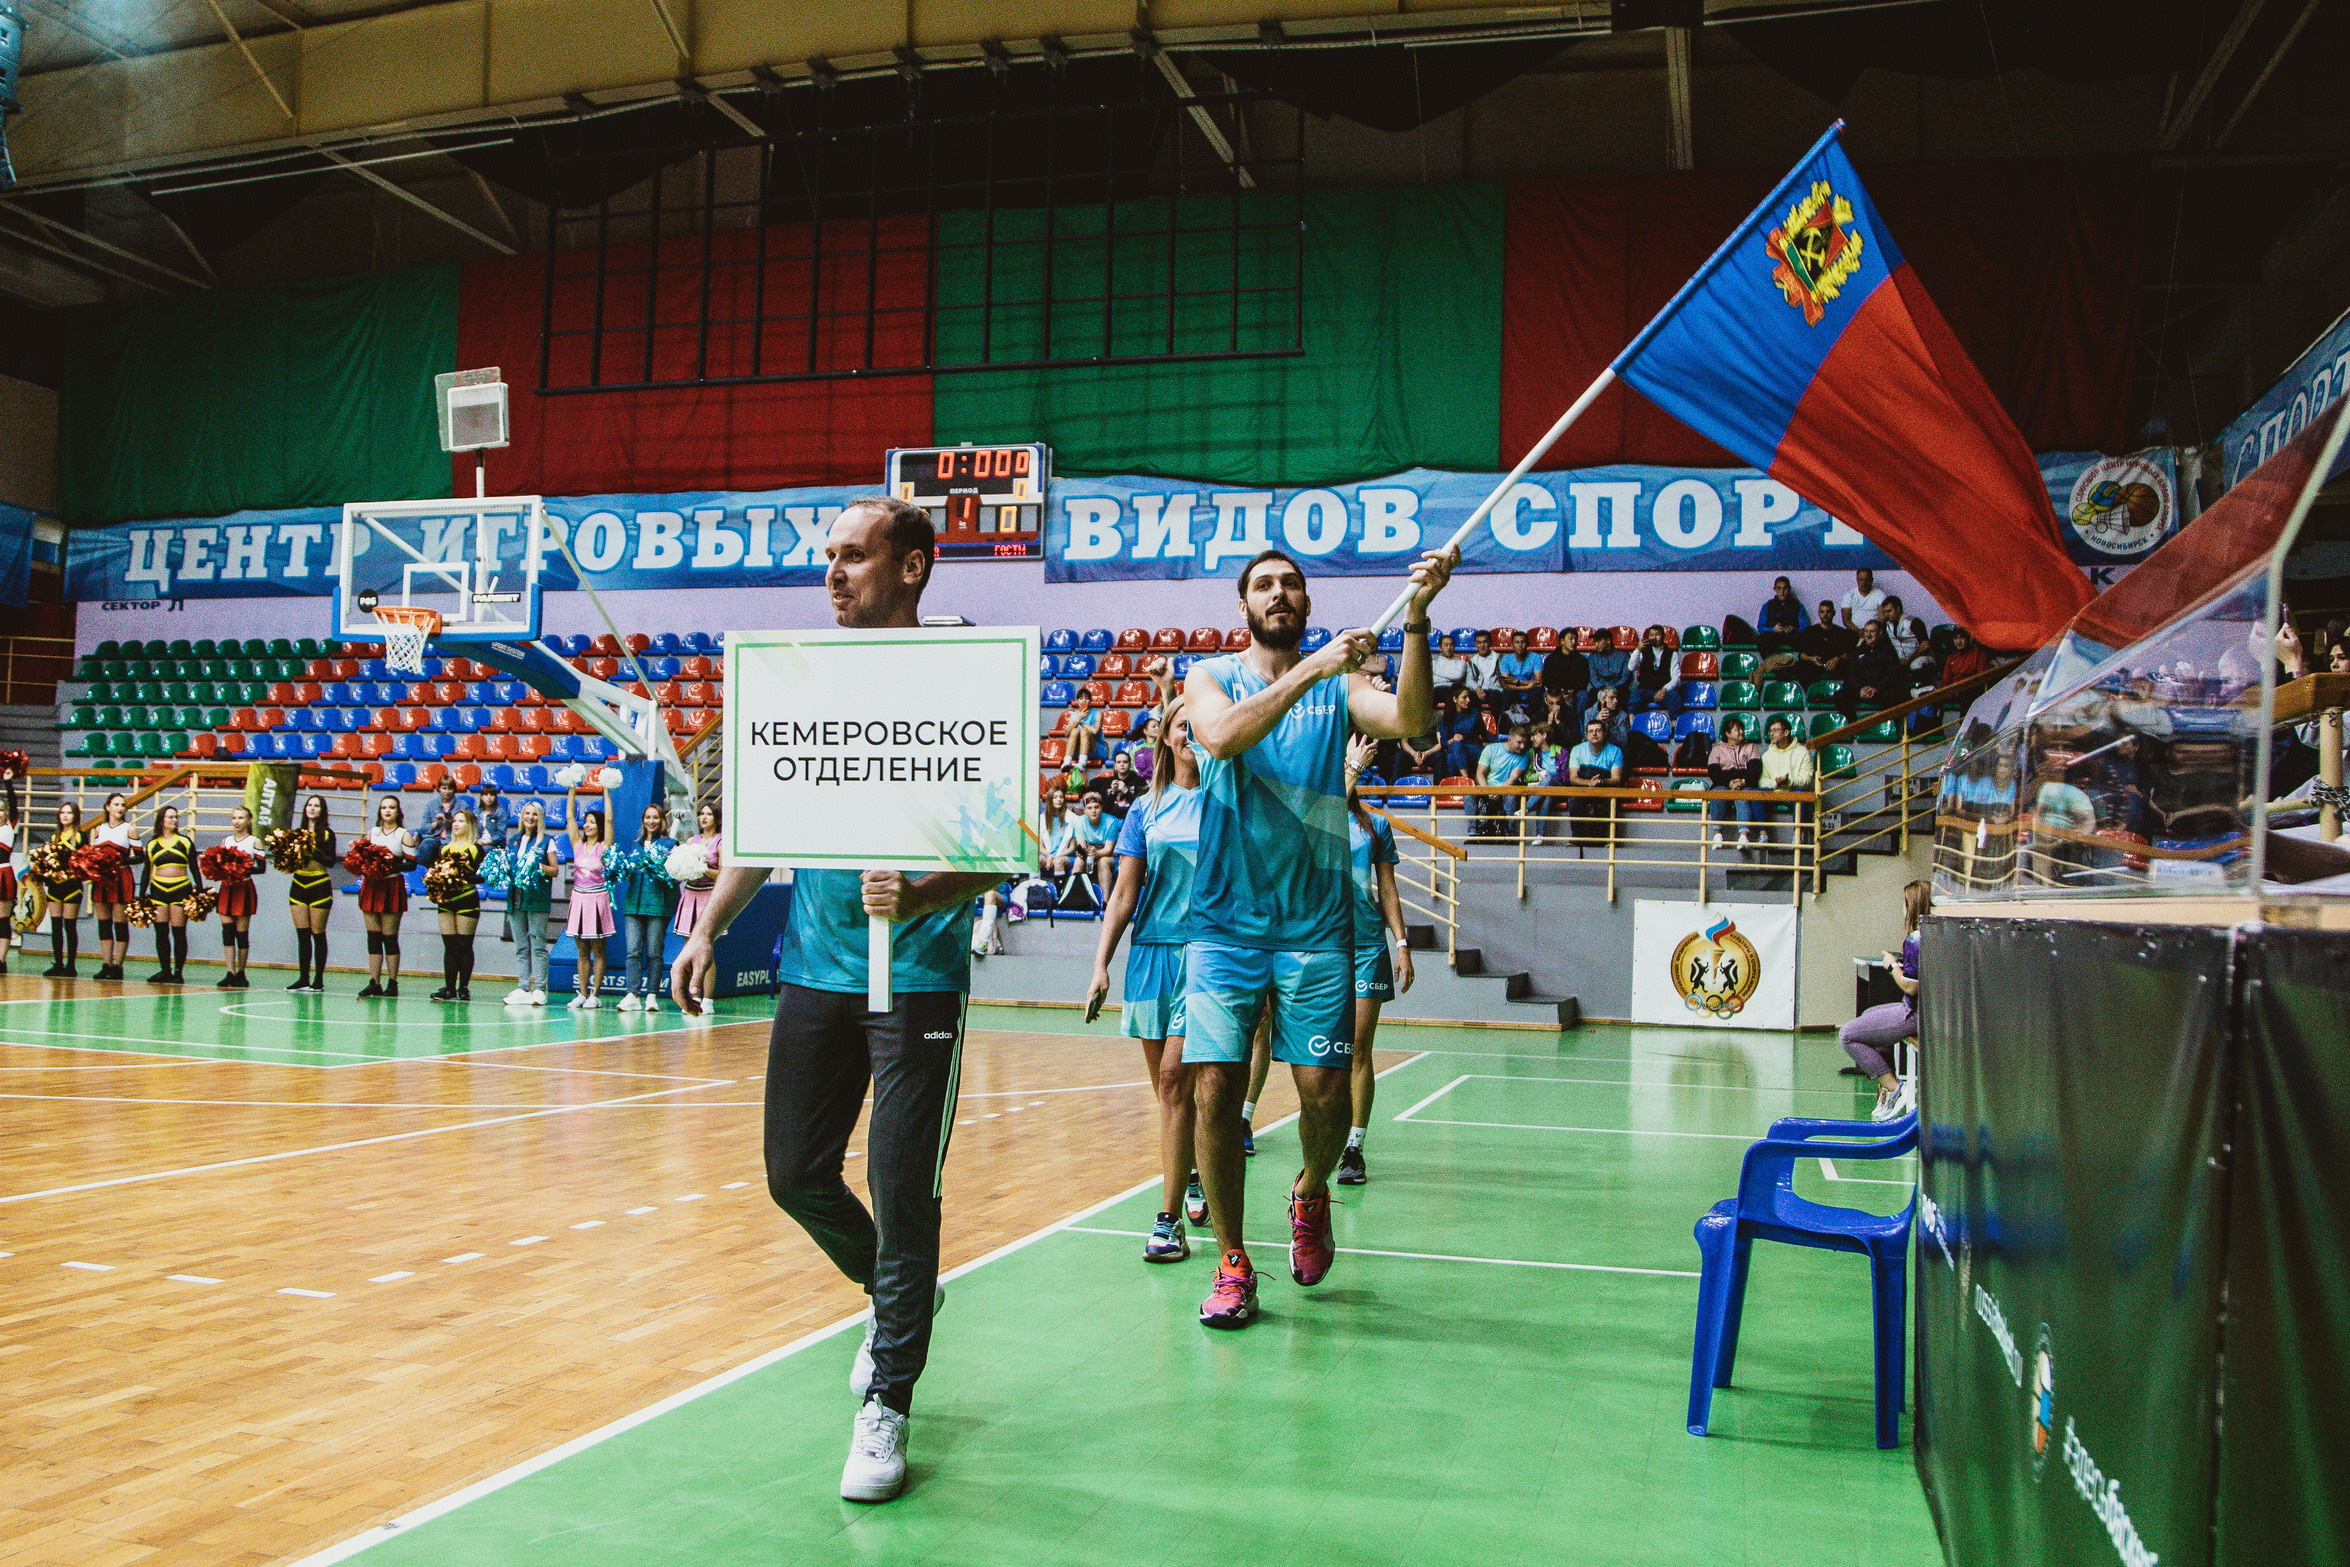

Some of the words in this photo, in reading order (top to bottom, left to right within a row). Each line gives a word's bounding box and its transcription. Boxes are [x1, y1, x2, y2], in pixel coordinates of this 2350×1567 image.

[124, 523, 371, 594] ЦЕНТР
[418, 506, 843, 575] ИГРОВЫХ
[1064, 488, 1421, 570] ВИДОВ
[2091, 534, 2147, 549] НОВОСИБИРСК
[994, 544, 1027, 556] ГОСТИ
[101, 600, 161, 611] СЕКТОР
[1306, 704, 1336, 716] СБЕР
[751, 719, 1008, 746] КЕМЕРОВСКОЕ
[773, 756, 982, 786] ОТДЕЛЕНИЕ
[736, 969, 780, 987] EASYPL
[1368, 982, 1389, 991] СБЕР
[923, 1030, 953, 1040] adidas
